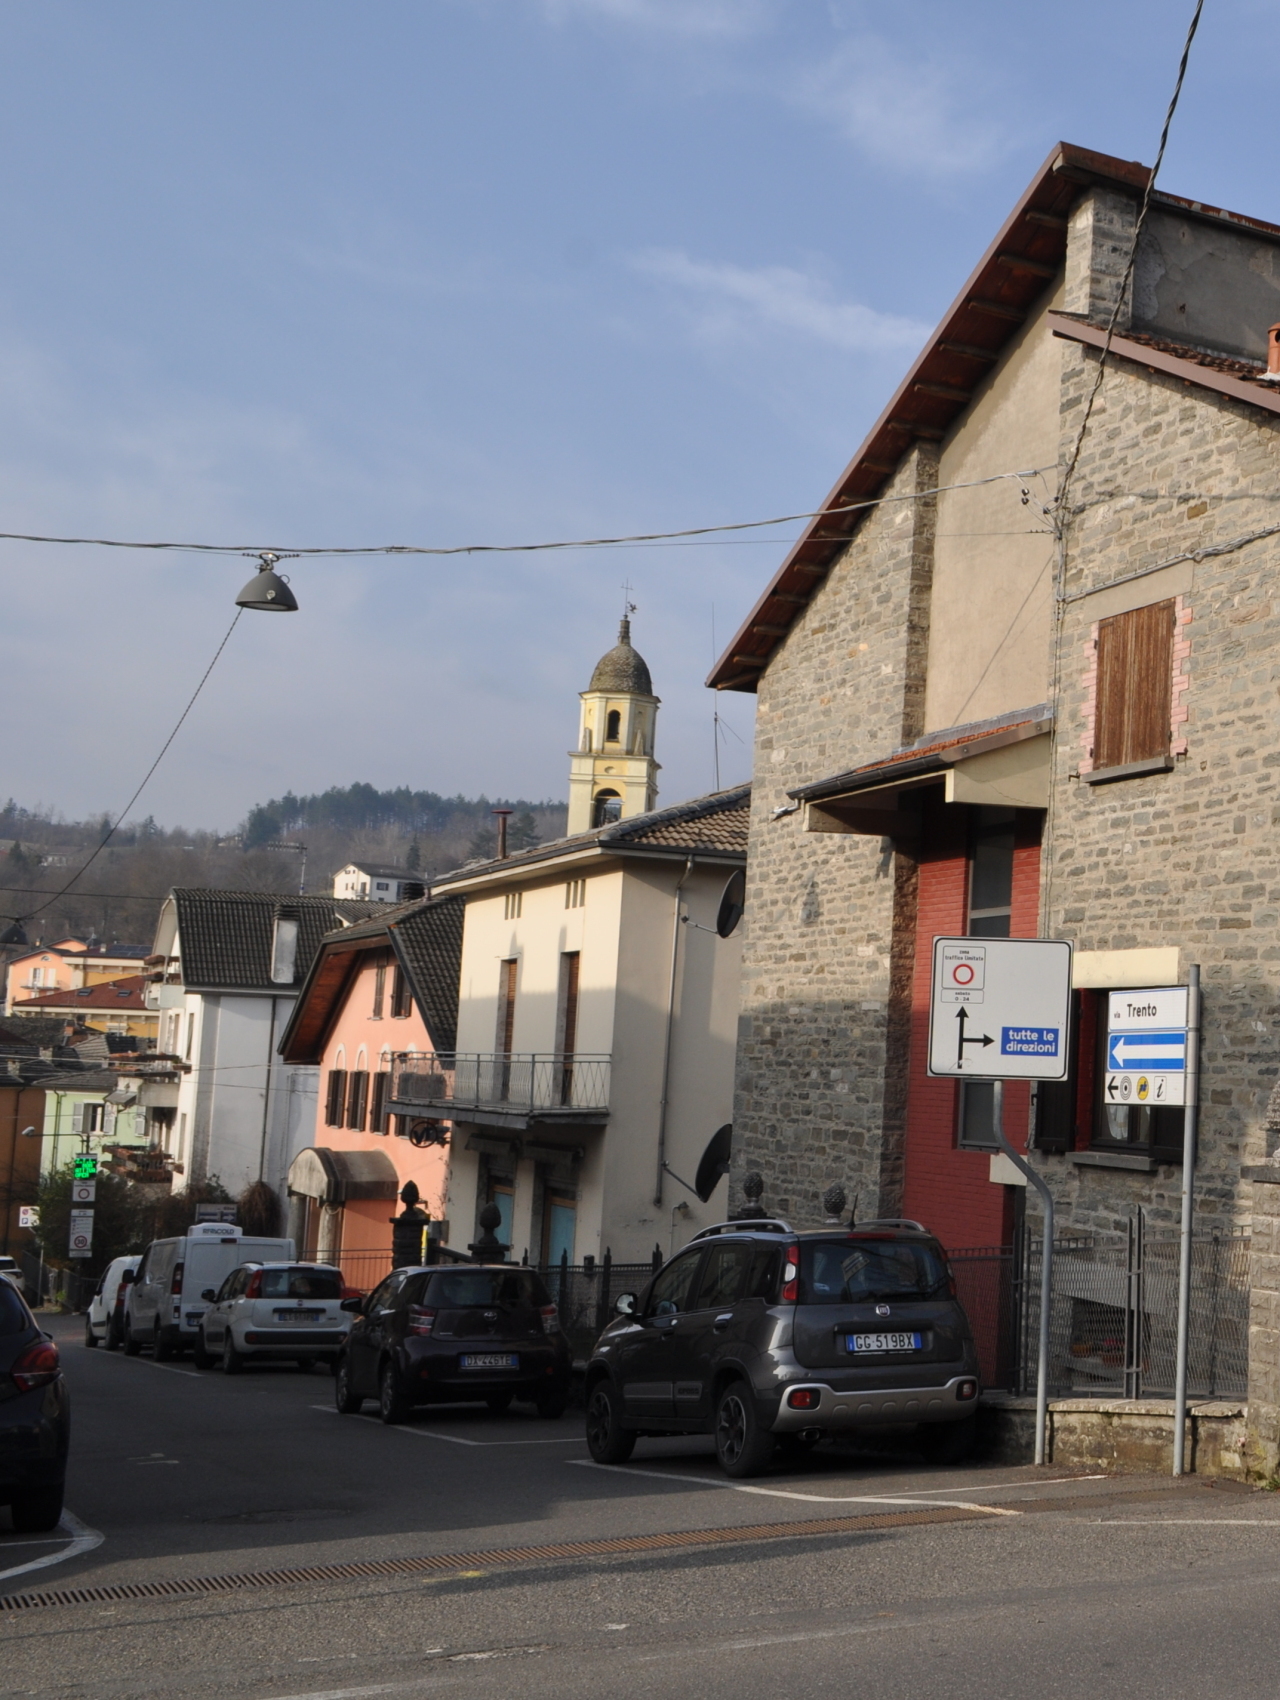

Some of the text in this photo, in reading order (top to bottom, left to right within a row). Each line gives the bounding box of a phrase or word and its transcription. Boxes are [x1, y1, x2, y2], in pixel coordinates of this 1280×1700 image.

[1113, 1003, 1157, 1019] via Trento
[1008, 1029, 1055, 1041] tutte le
[1006, 1041, 1056, 1053] direzioni
